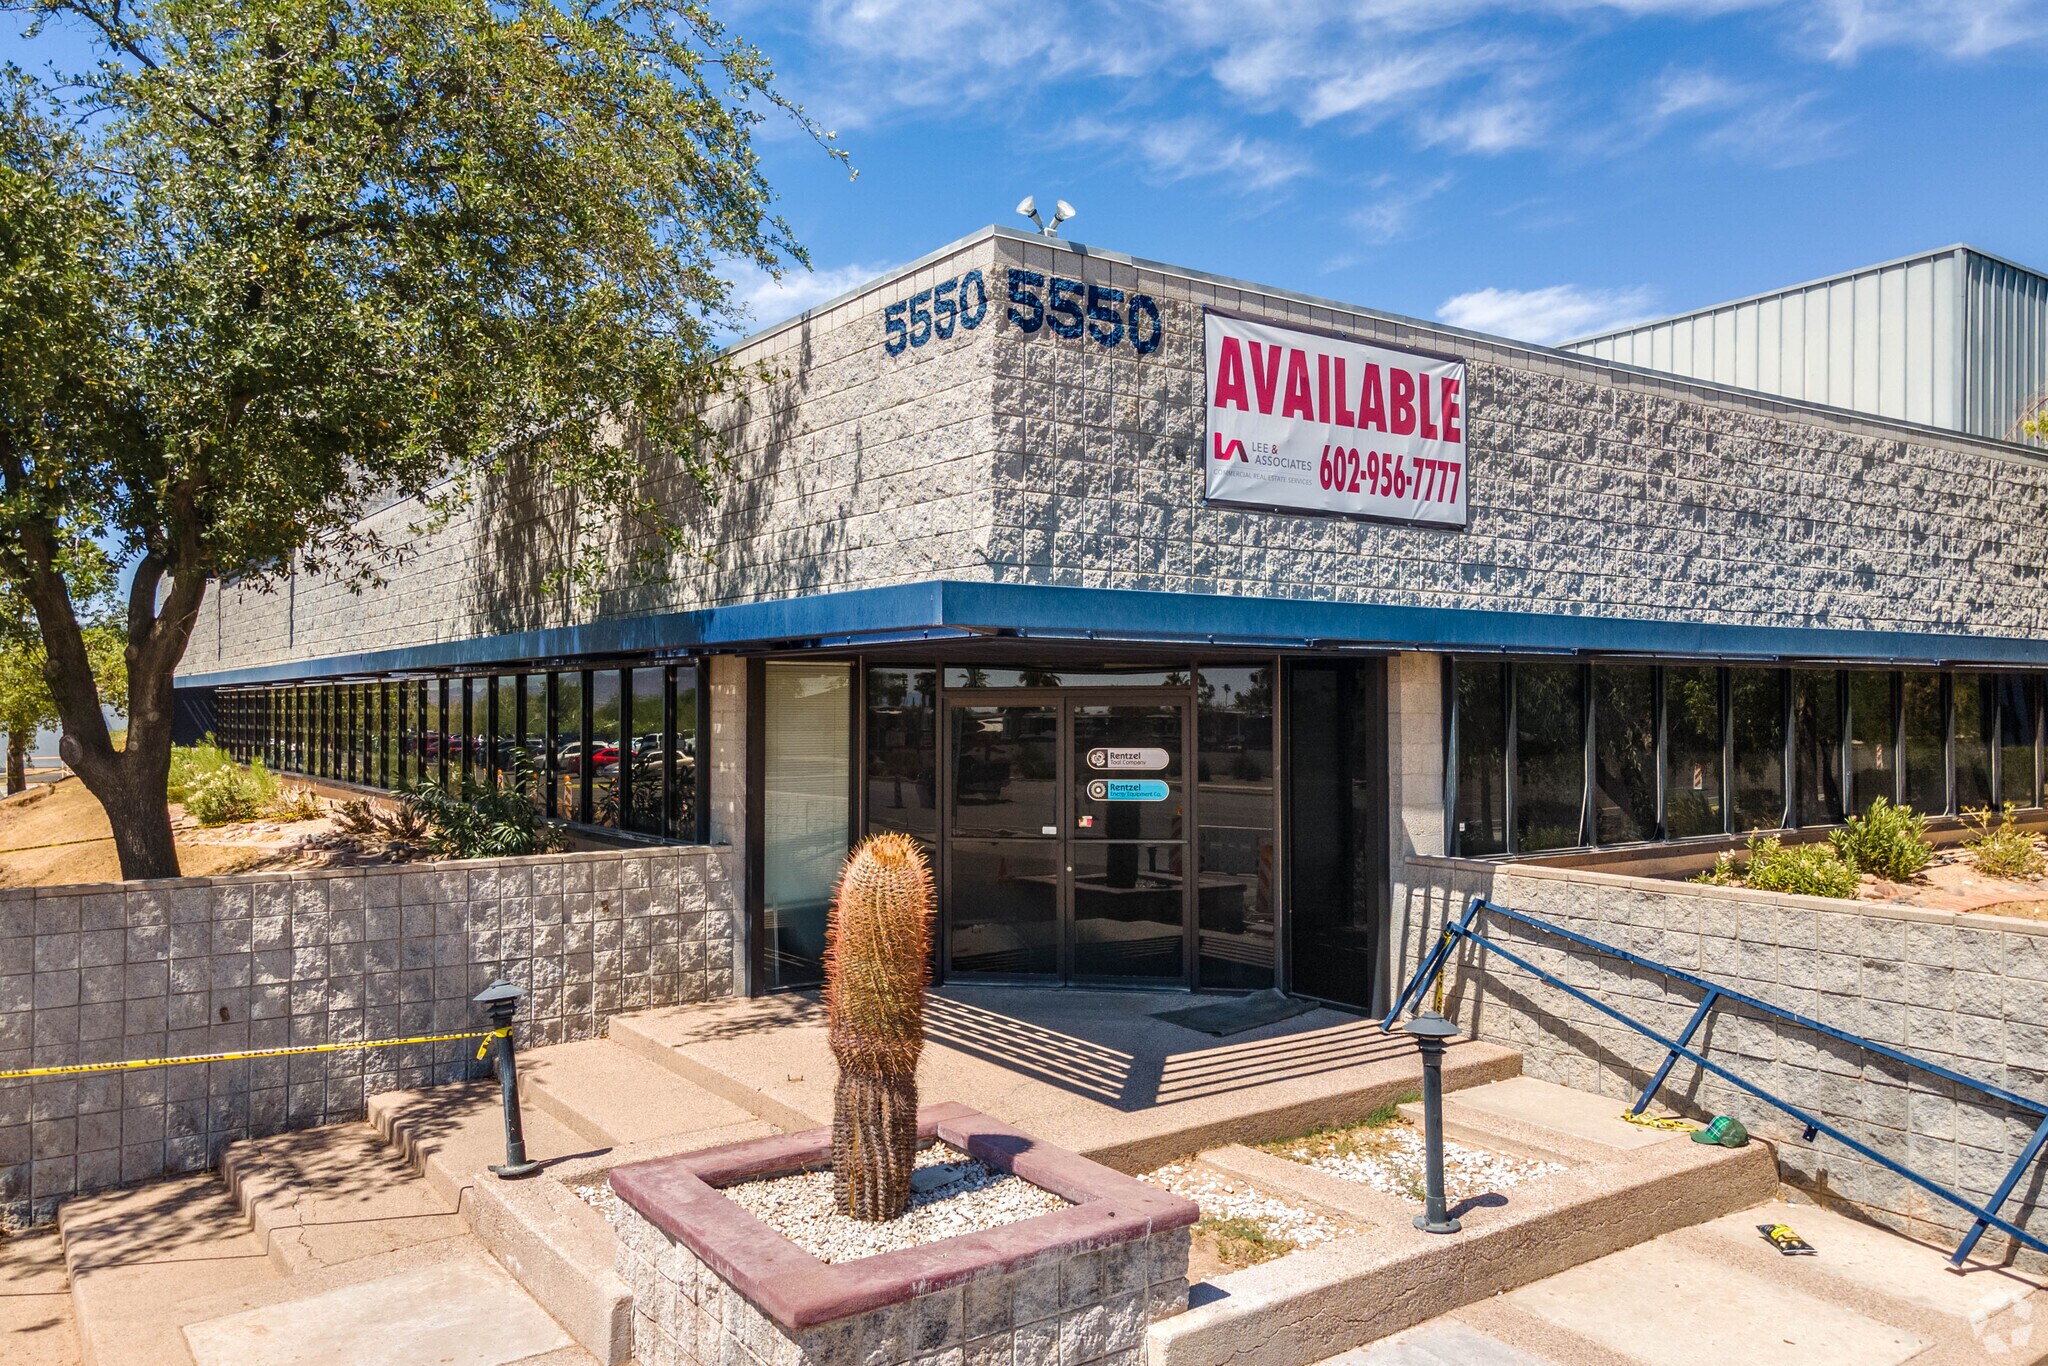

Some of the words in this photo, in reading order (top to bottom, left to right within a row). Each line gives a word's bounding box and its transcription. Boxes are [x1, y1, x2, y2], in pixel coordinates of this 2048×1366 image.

[885, 269, 988, 357] 5550
[1007, 268, 1162, 354] 5550
[1214, 335, 1461, 443] AVAILABLE
[1252, 442, 1269, 454] LEE
[1271, 444, 1279, 455] &
[1254, 455, 1312, 471] ASSOCIATES
[1213, 468, 1252, 479] COMMERCIAL
[1253, 472, 1267, 481] REAL
[1268, 474, 1286, 483] ESTATE
[1288, 476, 1313, 486] SERVICES
[1320, 445, 1461, 504] 602-956-7777
[1110, 752, 1141, 760] Rentzel
